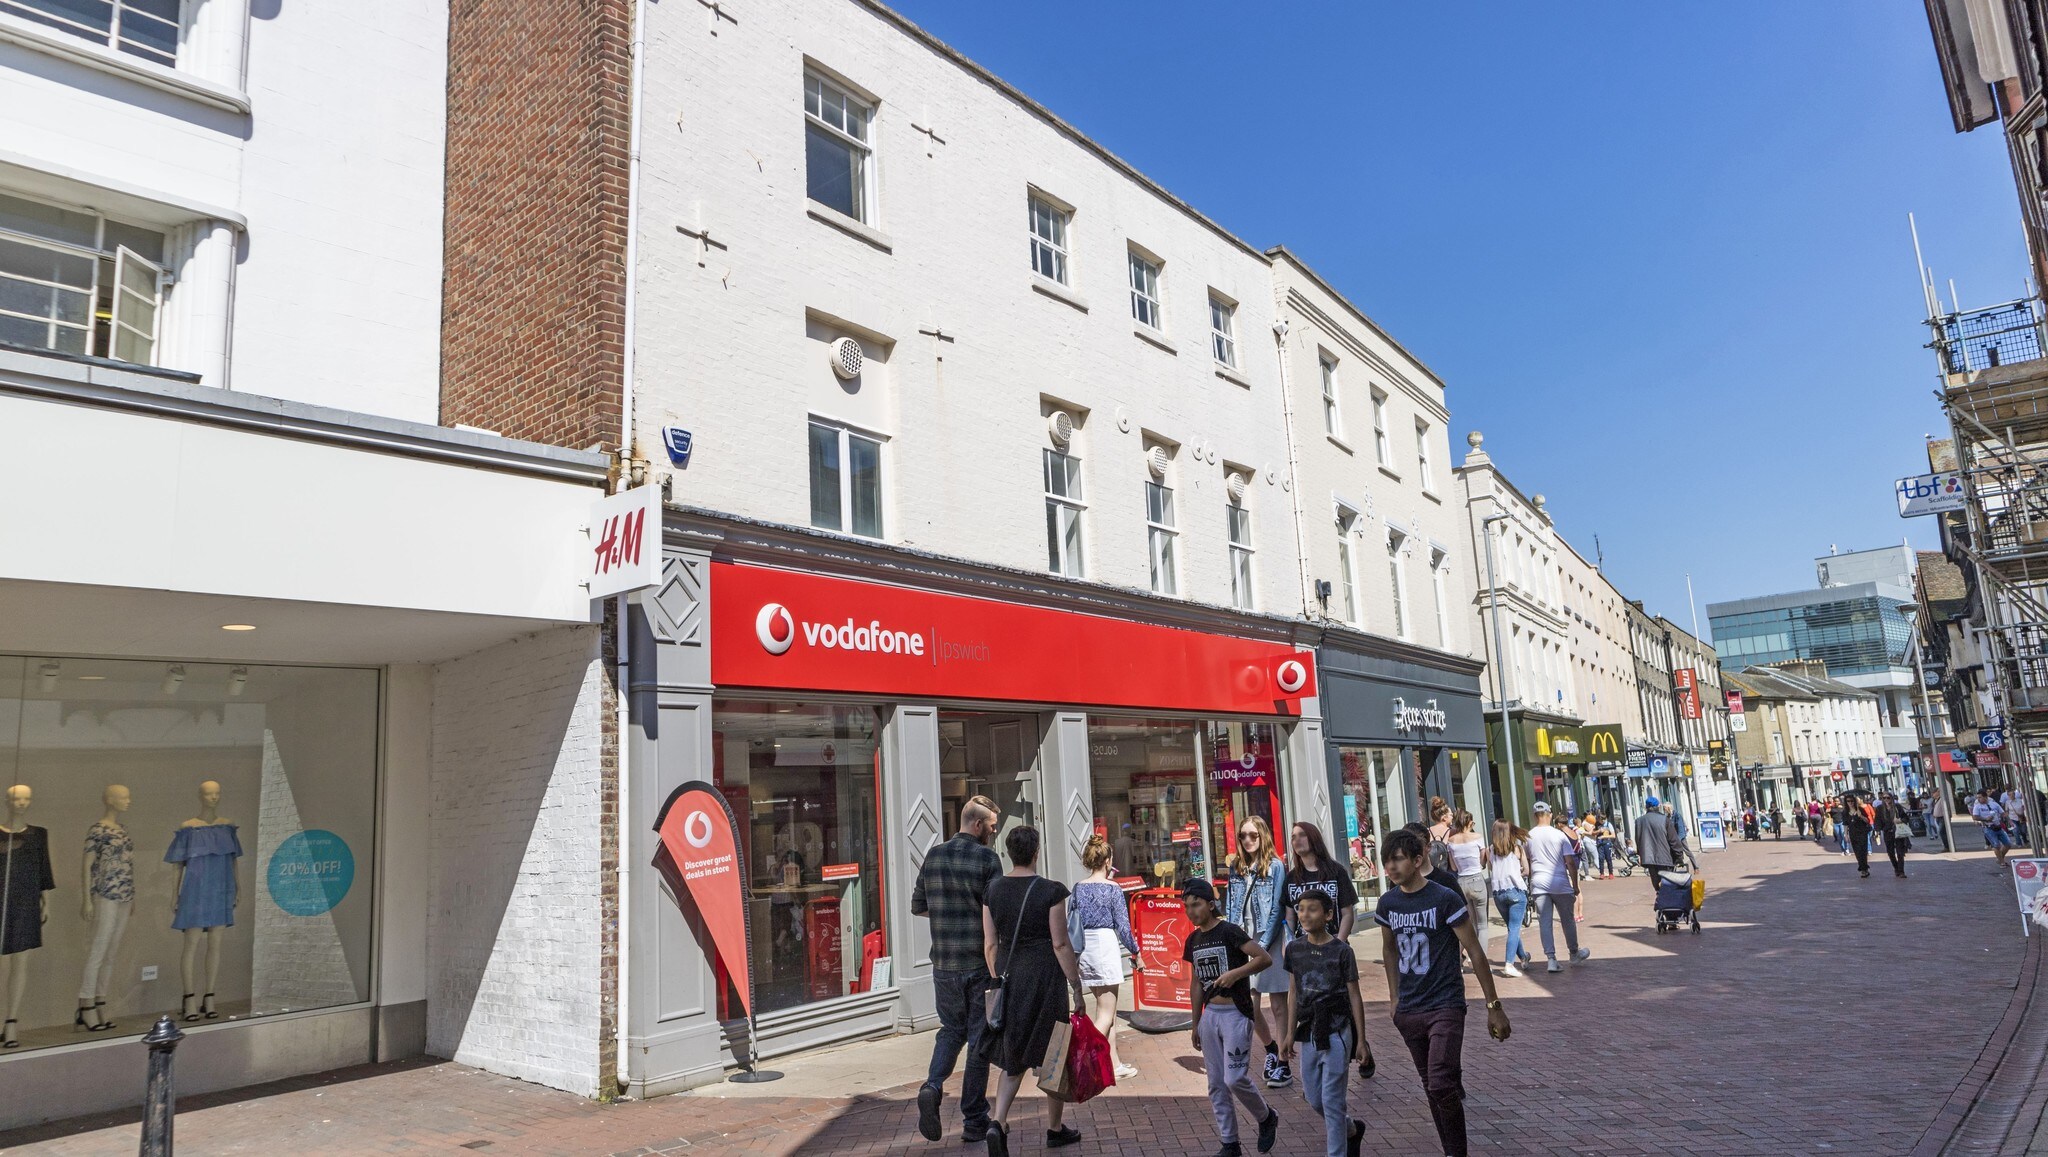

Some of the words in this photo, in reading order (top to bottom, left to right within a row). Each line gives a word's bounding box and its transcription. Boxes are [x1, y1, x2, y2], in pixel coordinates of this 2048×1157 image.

[1900, 476, 1941, 499] tbf
[595, 507, 645, 575] H&M
[802, 618, 924, 656] vodafone
[939, 637, 991, 664] Ipswich
[1681, 669, 1696, 718] COTSOLD
[279, 862, 310, 876] 20%
[313, 860, 342, 874] OFF!
[685, 858, 714, 870] Discover
[714, 854, 732, 866] great
[685, 869, 705, 880] deals
[705, 868, 712, 876] in
[712, 865, 730, 875] store
[1388, 907, 1437, 930] BROOKLYN
